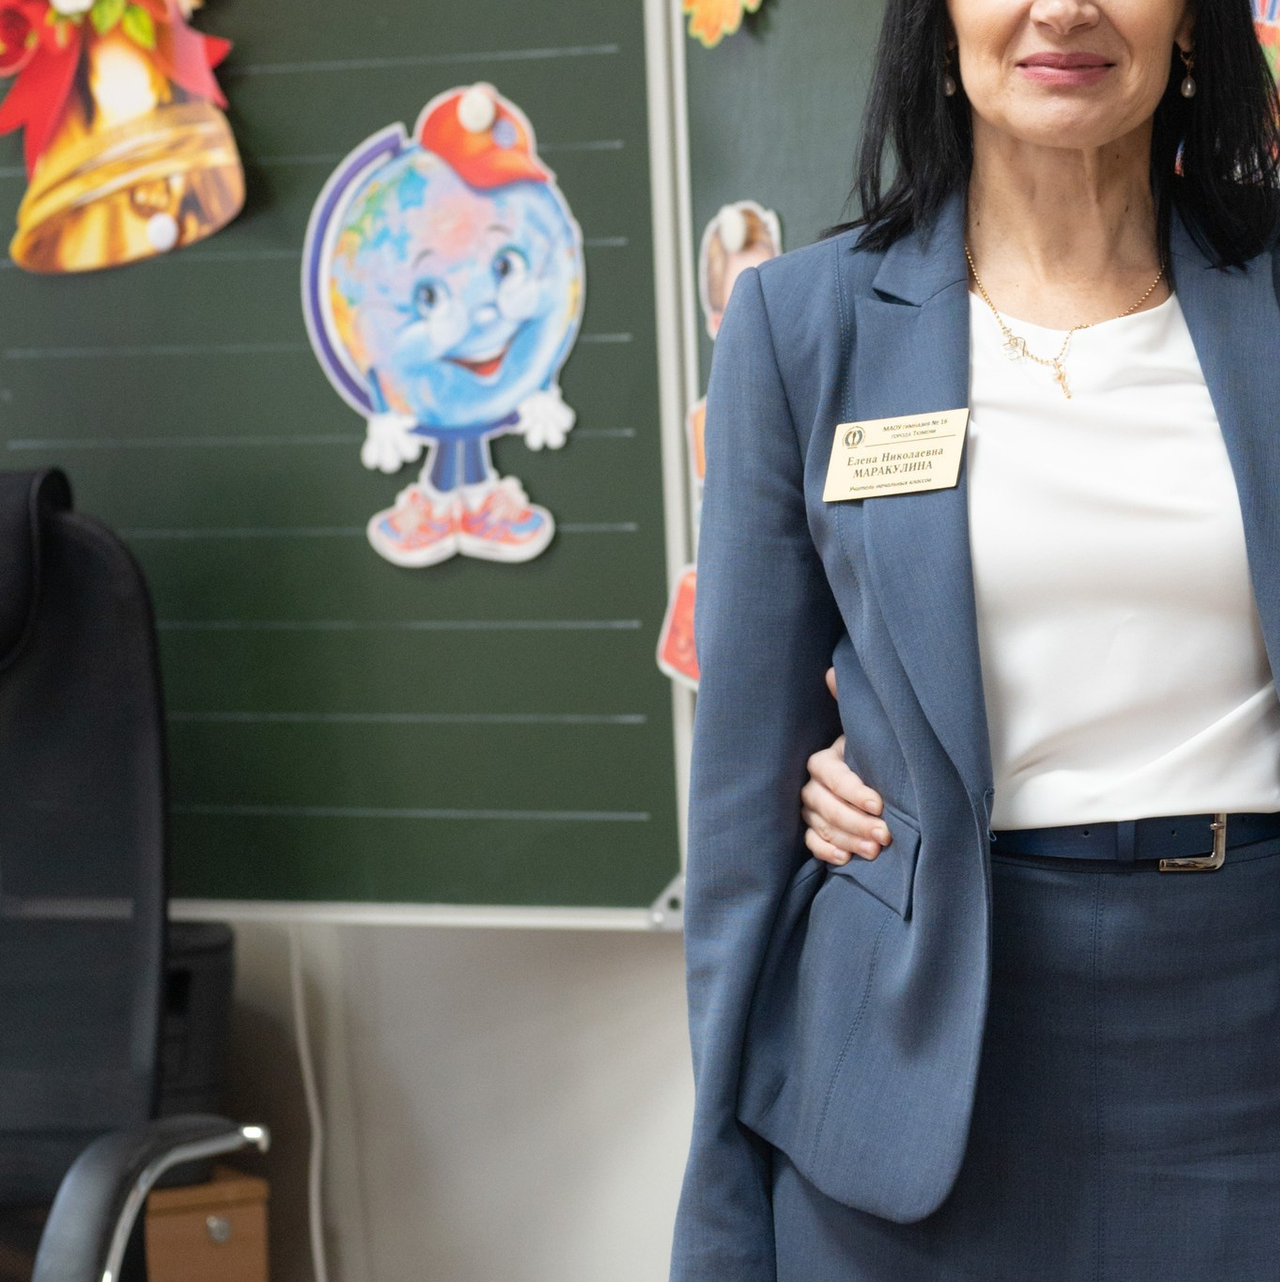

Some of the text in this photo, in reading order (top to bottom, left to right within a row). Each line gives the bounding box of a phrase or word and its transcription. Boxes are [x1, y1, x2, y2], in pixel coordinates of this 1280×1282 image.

[847, 447, 944, 467] Елена Николаевна
[852, 460, 933, 479] МАРАКУЛИНА
